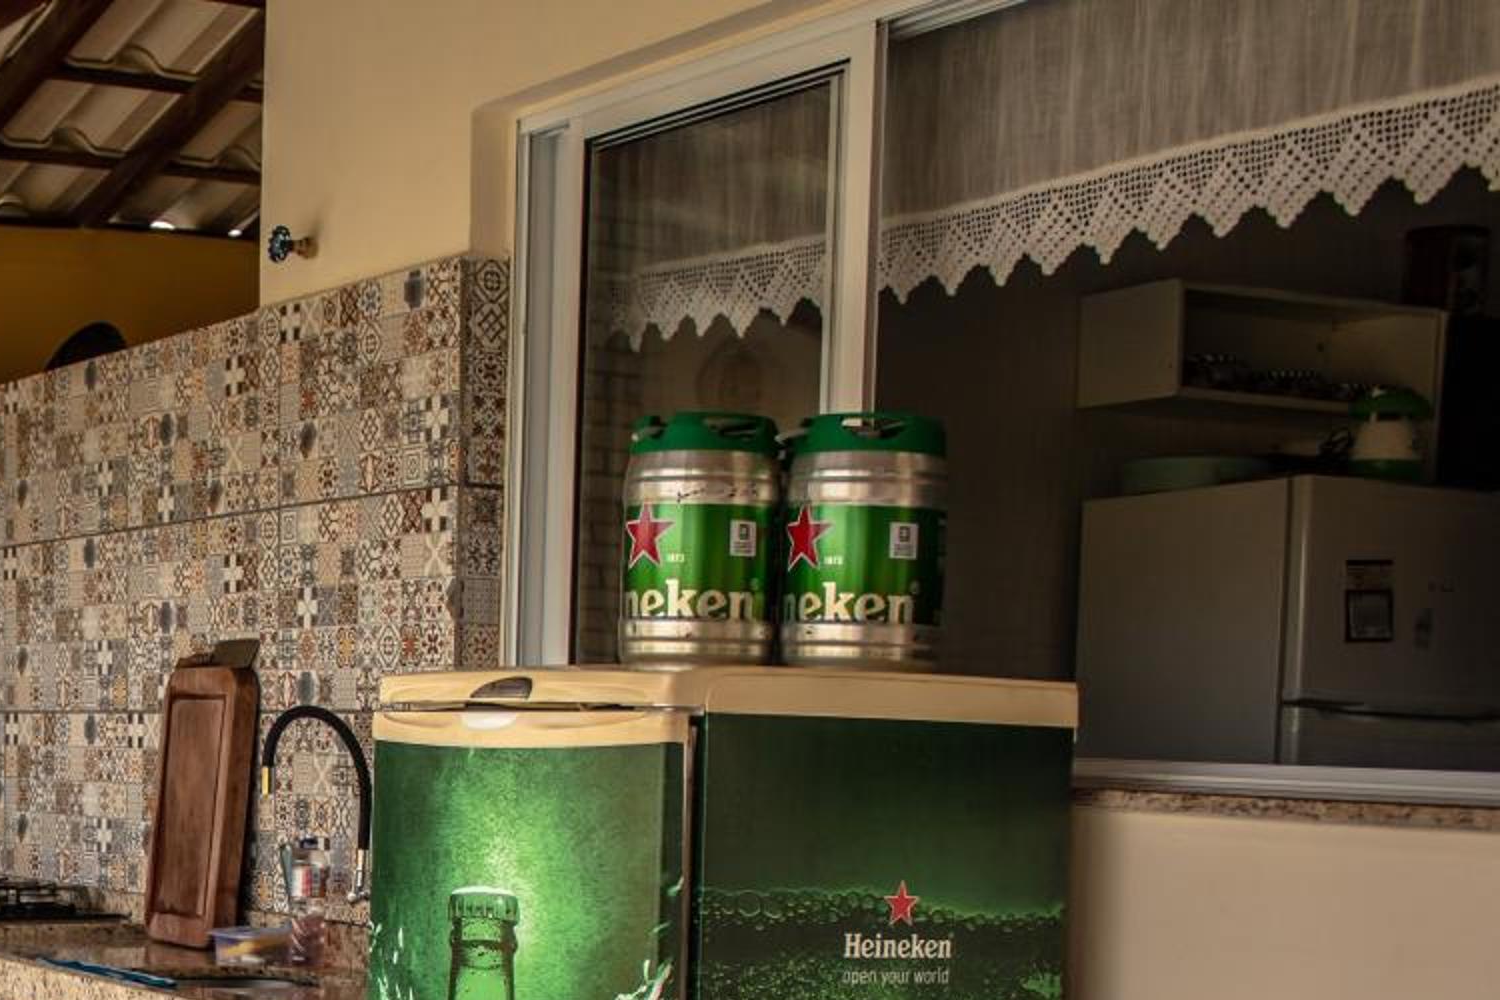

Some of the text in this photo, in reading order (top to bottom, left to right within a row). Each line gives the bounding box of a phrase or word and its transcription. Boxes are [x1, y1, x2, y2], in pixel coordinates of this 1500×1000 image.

[843, 932, 953, 959] Heineken
[842, 968, 949, 986] open your world
